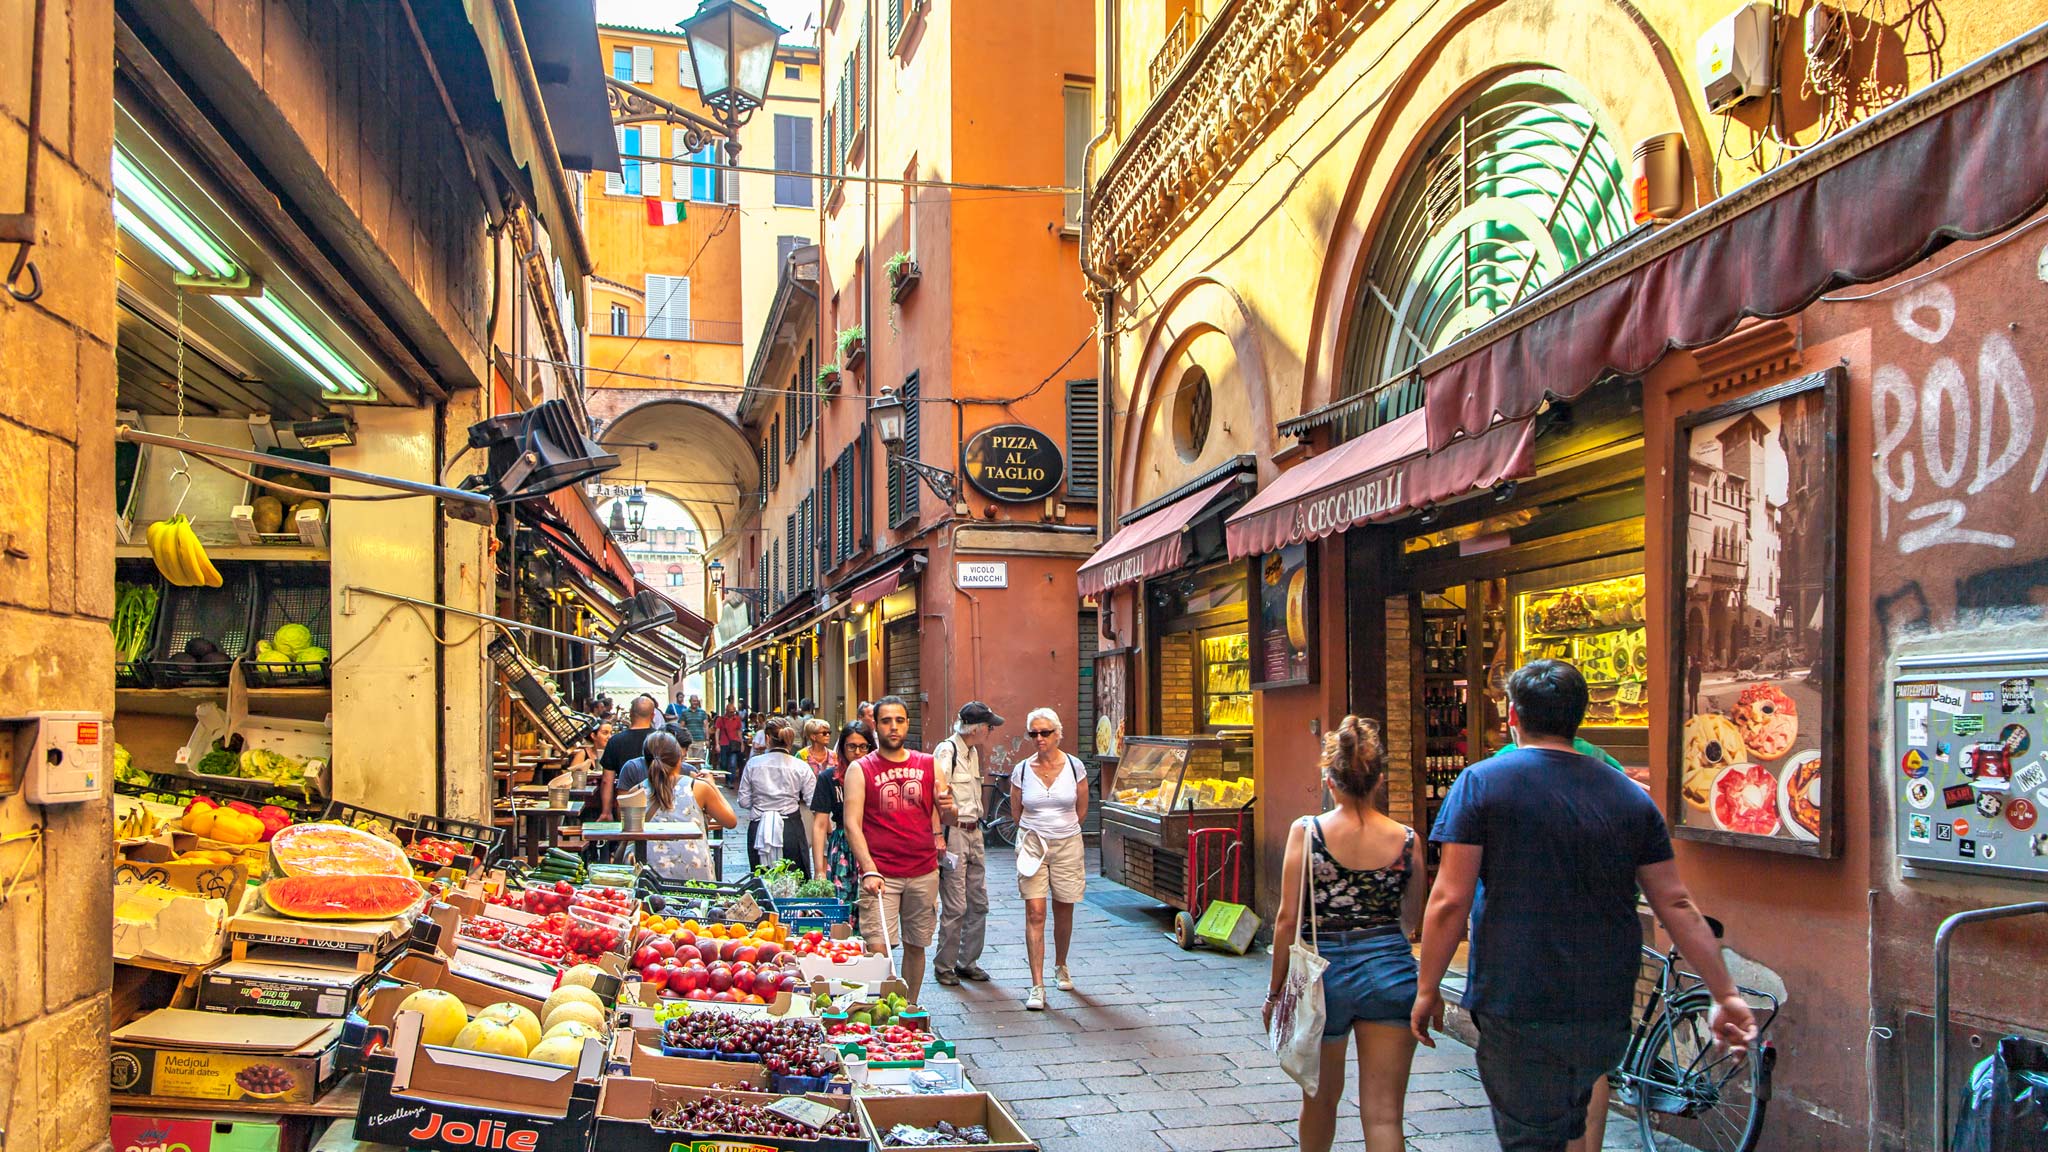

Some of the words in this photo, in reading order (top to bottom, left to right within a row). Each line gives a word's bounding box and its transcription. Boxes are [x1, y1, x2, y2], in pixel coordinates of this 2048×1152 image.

[992, 436, 1038, 449] PIZZA
[1005, 452, 1026, 464] AL
[985, 466, 1045, 480] TAGLIO
[1308, 472, 1402, 532] CECCARELLI
[1104, 553, 1143, 588] CECCARELLI
[165, 1055, 210, 1068] Medjoul
[164, 1066, 195, 1076] Natural
[196, 1068, 220, 1077] dates
[368, 1106, 426, 1127] l'Eccellenza
[409, 1112, 540, 1152] Jolie
